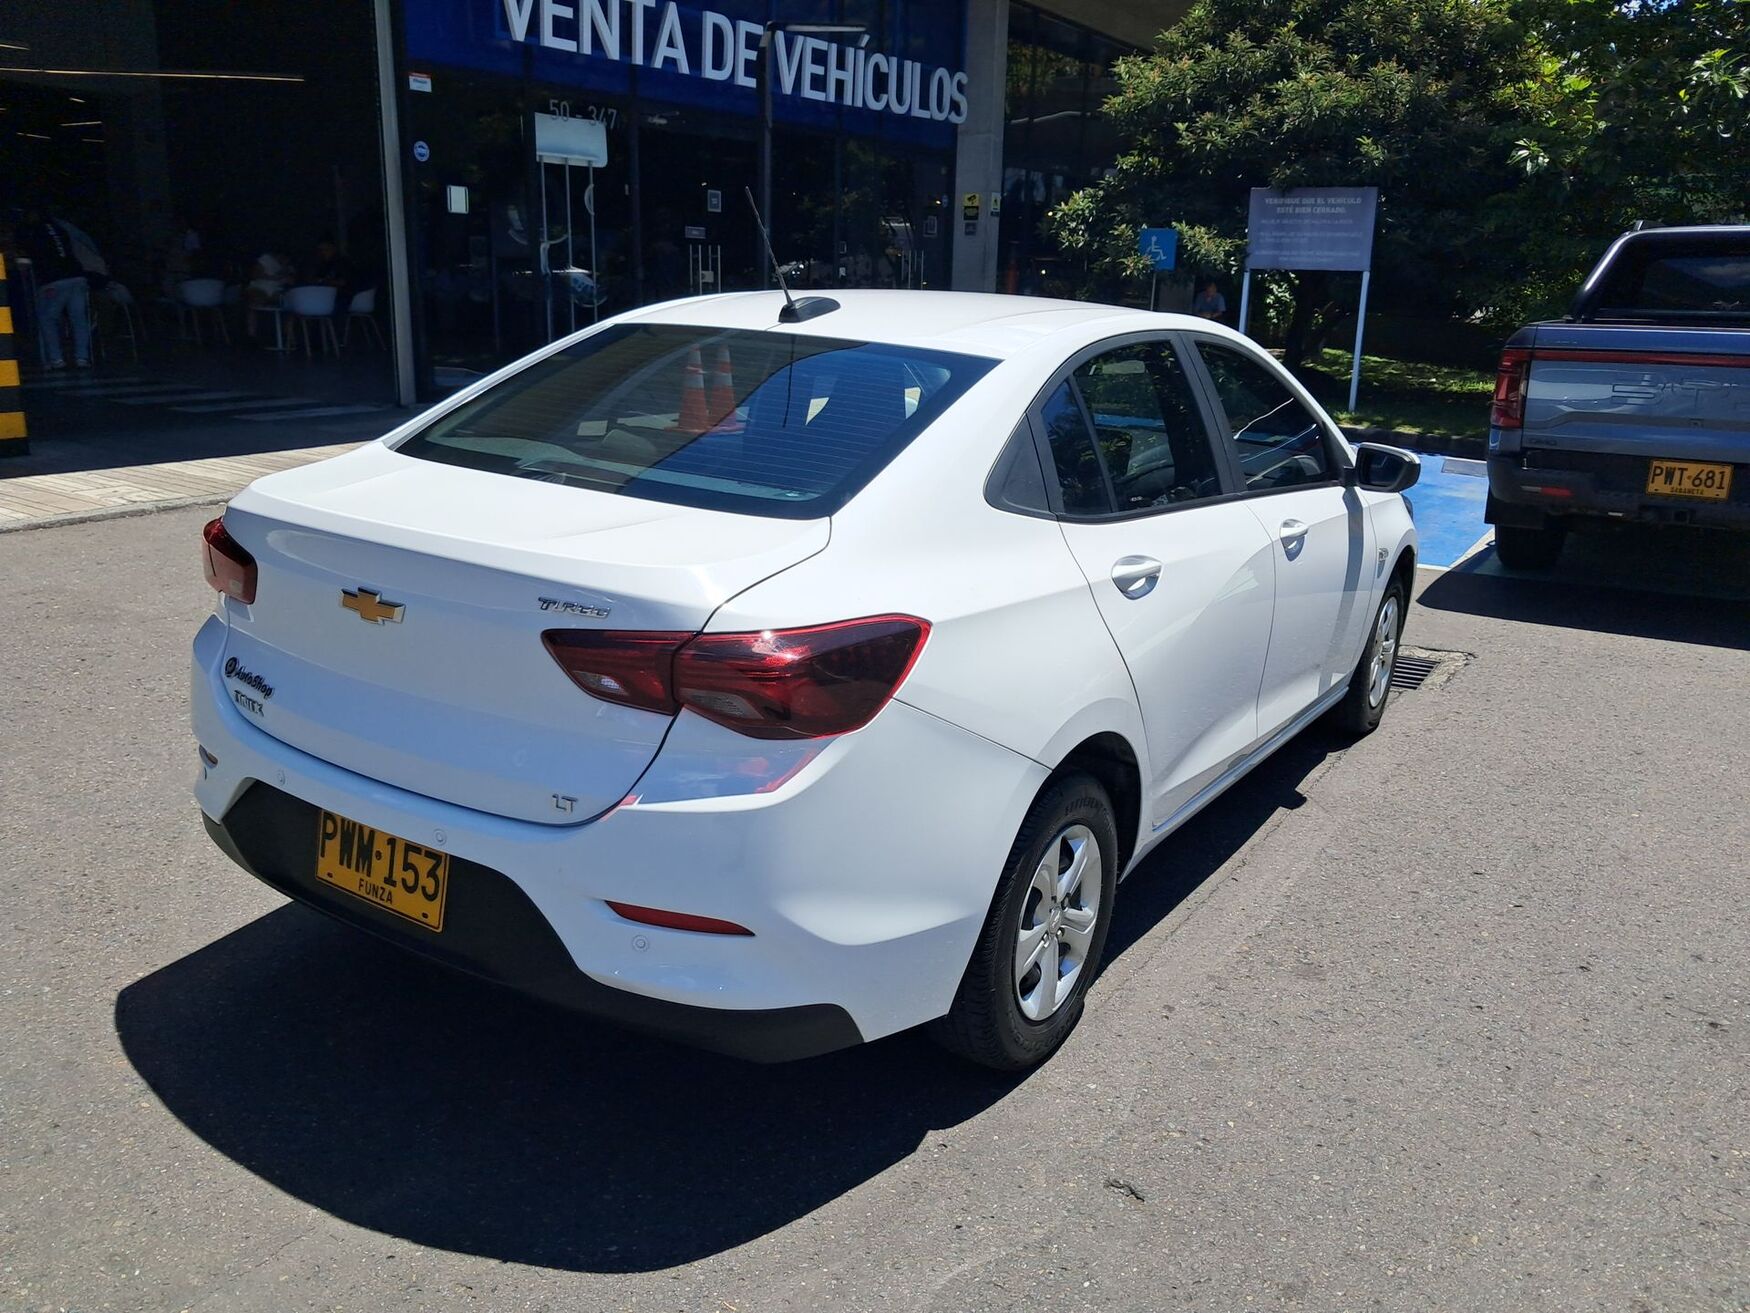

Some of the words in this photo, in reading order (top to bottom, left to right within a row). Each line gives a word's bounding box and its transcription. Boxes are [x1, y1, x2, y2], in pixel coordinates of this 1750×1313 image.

[504, 0, 690, 75] VENTA
[701, 10, 764, 89] DE
[774, 34, 969, 124] VEHÍCULOS
[549, 99, 570, 122] 50
[552, 793, 579, 813] LT
[358, 877, 394, 905] FUNZA
